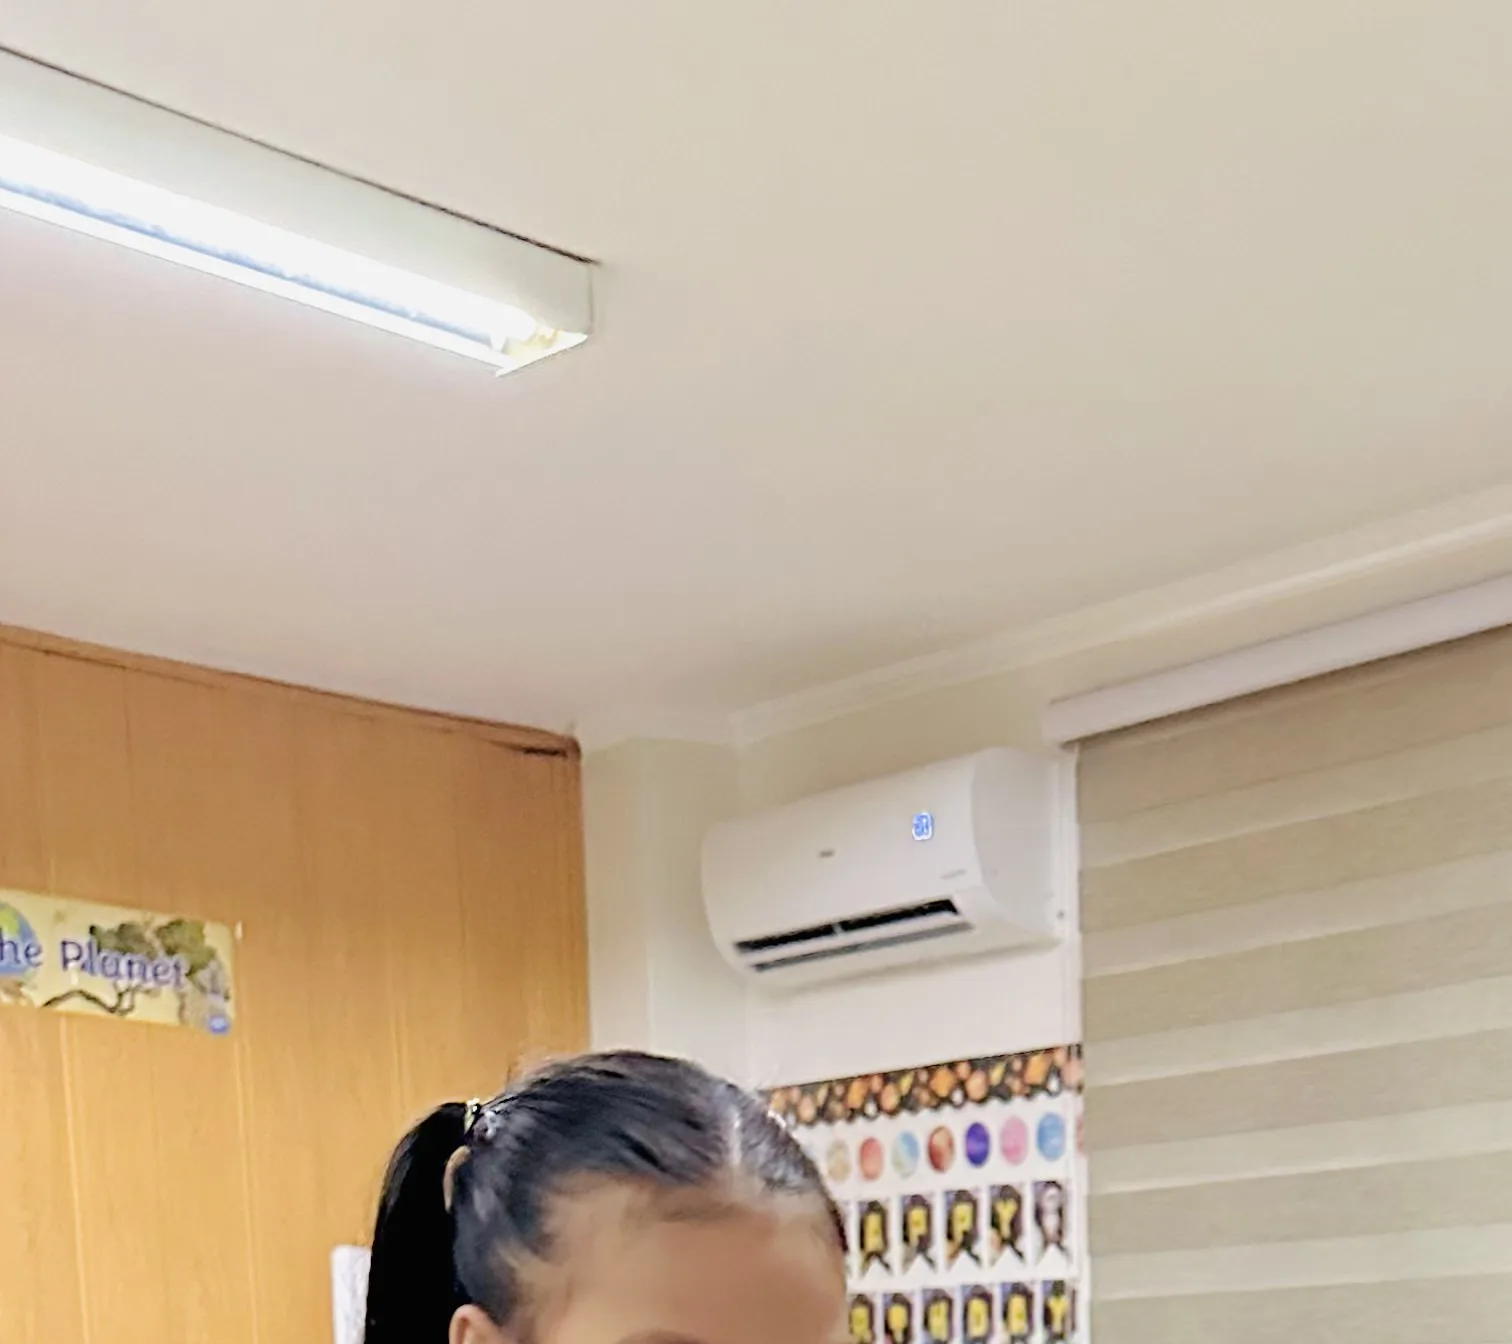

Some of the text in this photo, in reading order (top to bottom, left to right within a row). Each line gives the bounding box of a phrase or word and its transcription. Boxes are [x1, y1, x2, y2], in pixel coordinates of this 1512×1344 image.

[0, 929, 184, 988] he Planet
[863, 1198, 1018, 1252] APPY
